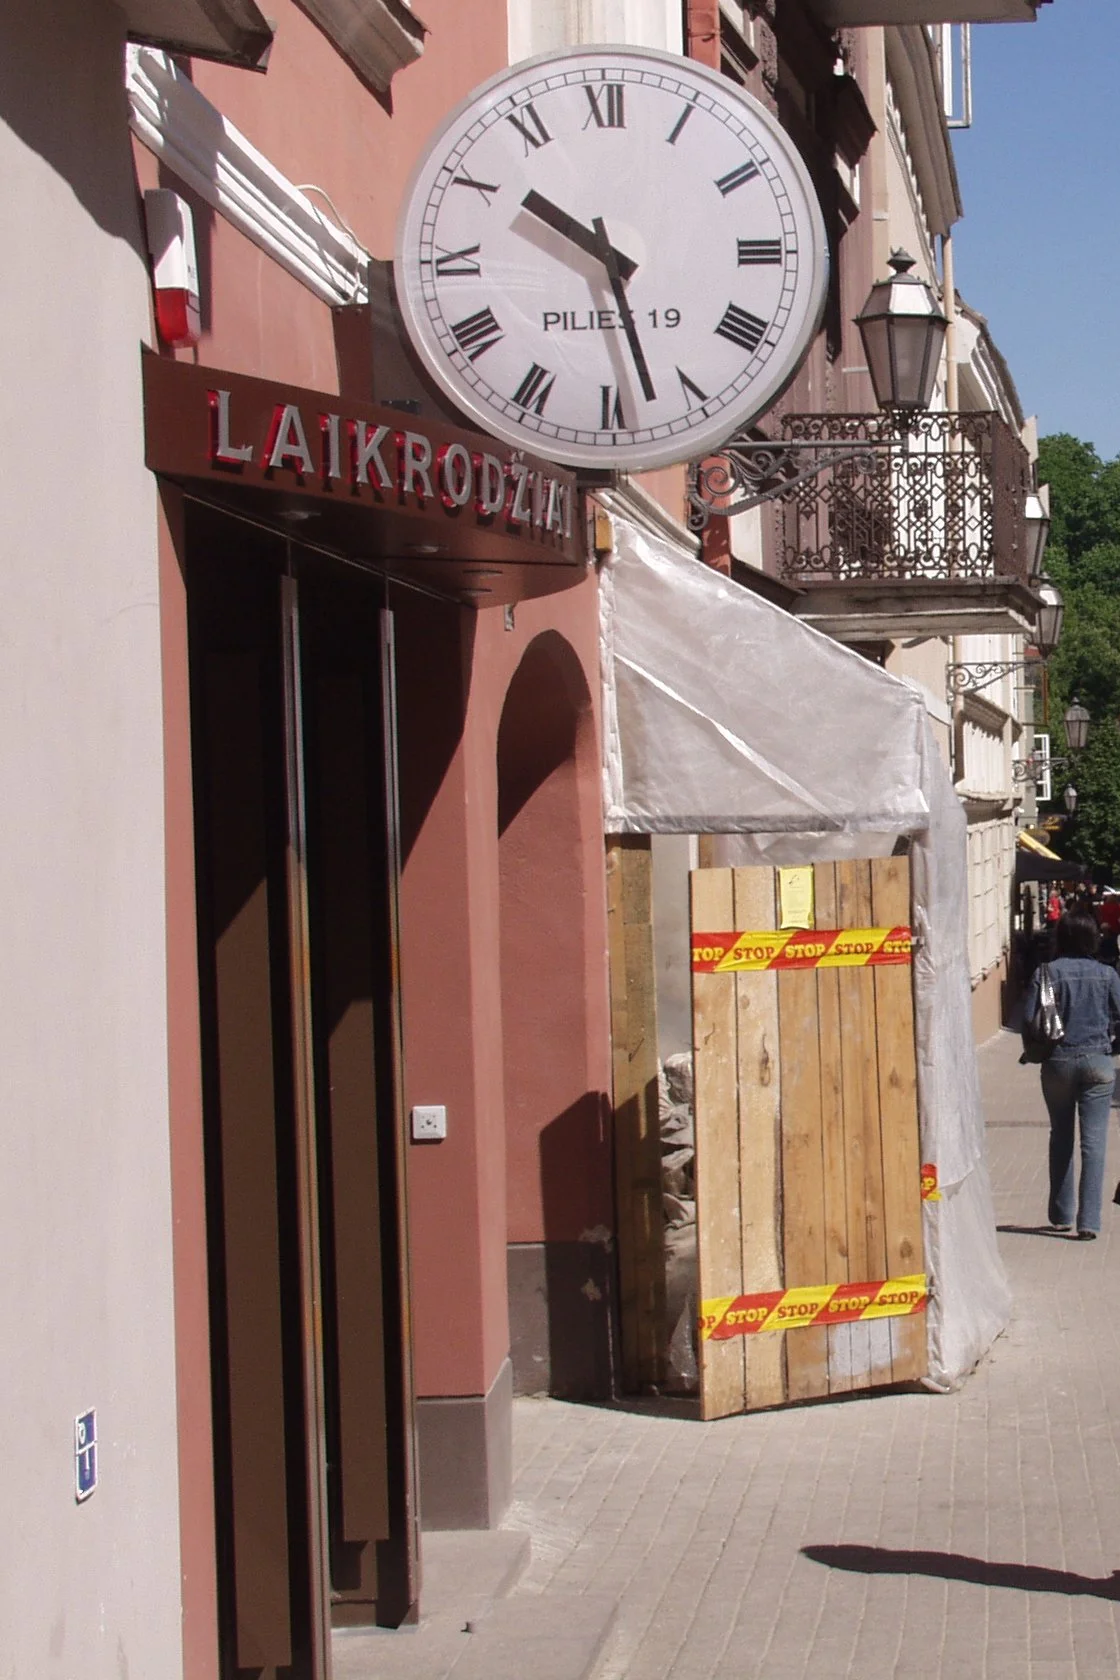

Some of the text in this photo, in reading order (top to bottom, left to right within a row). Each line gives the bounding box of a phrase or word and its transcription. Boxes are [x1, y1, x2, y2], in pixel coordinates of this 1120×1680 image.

[582, 83, 627, 130] XII
[665, 103, 694, 145] I
[504, 101, 555, 158] XI
[450, 164, 502, 207] X
[714, 159, 762, 197] II
[434, 243, 482, 278] IX
[737, 238, 783, 267] III
[450, 305, 506, 363] VIII
[648, 308, 681, 329] 19
[511, 362, 557, 417] VII
[675, 365, 710, 411] V
[208, 388, 574, 540] LAIKRODŽIAI
[693, 939, 911, 962] TOP STOP STOP STOP STO
[725, 1308, 769, 1325] STOP
[777, 1302, 820, 1318] STOP
[828, 1295, 870, 1313] STOP
[878, 1290, 919, 1307] STOP
